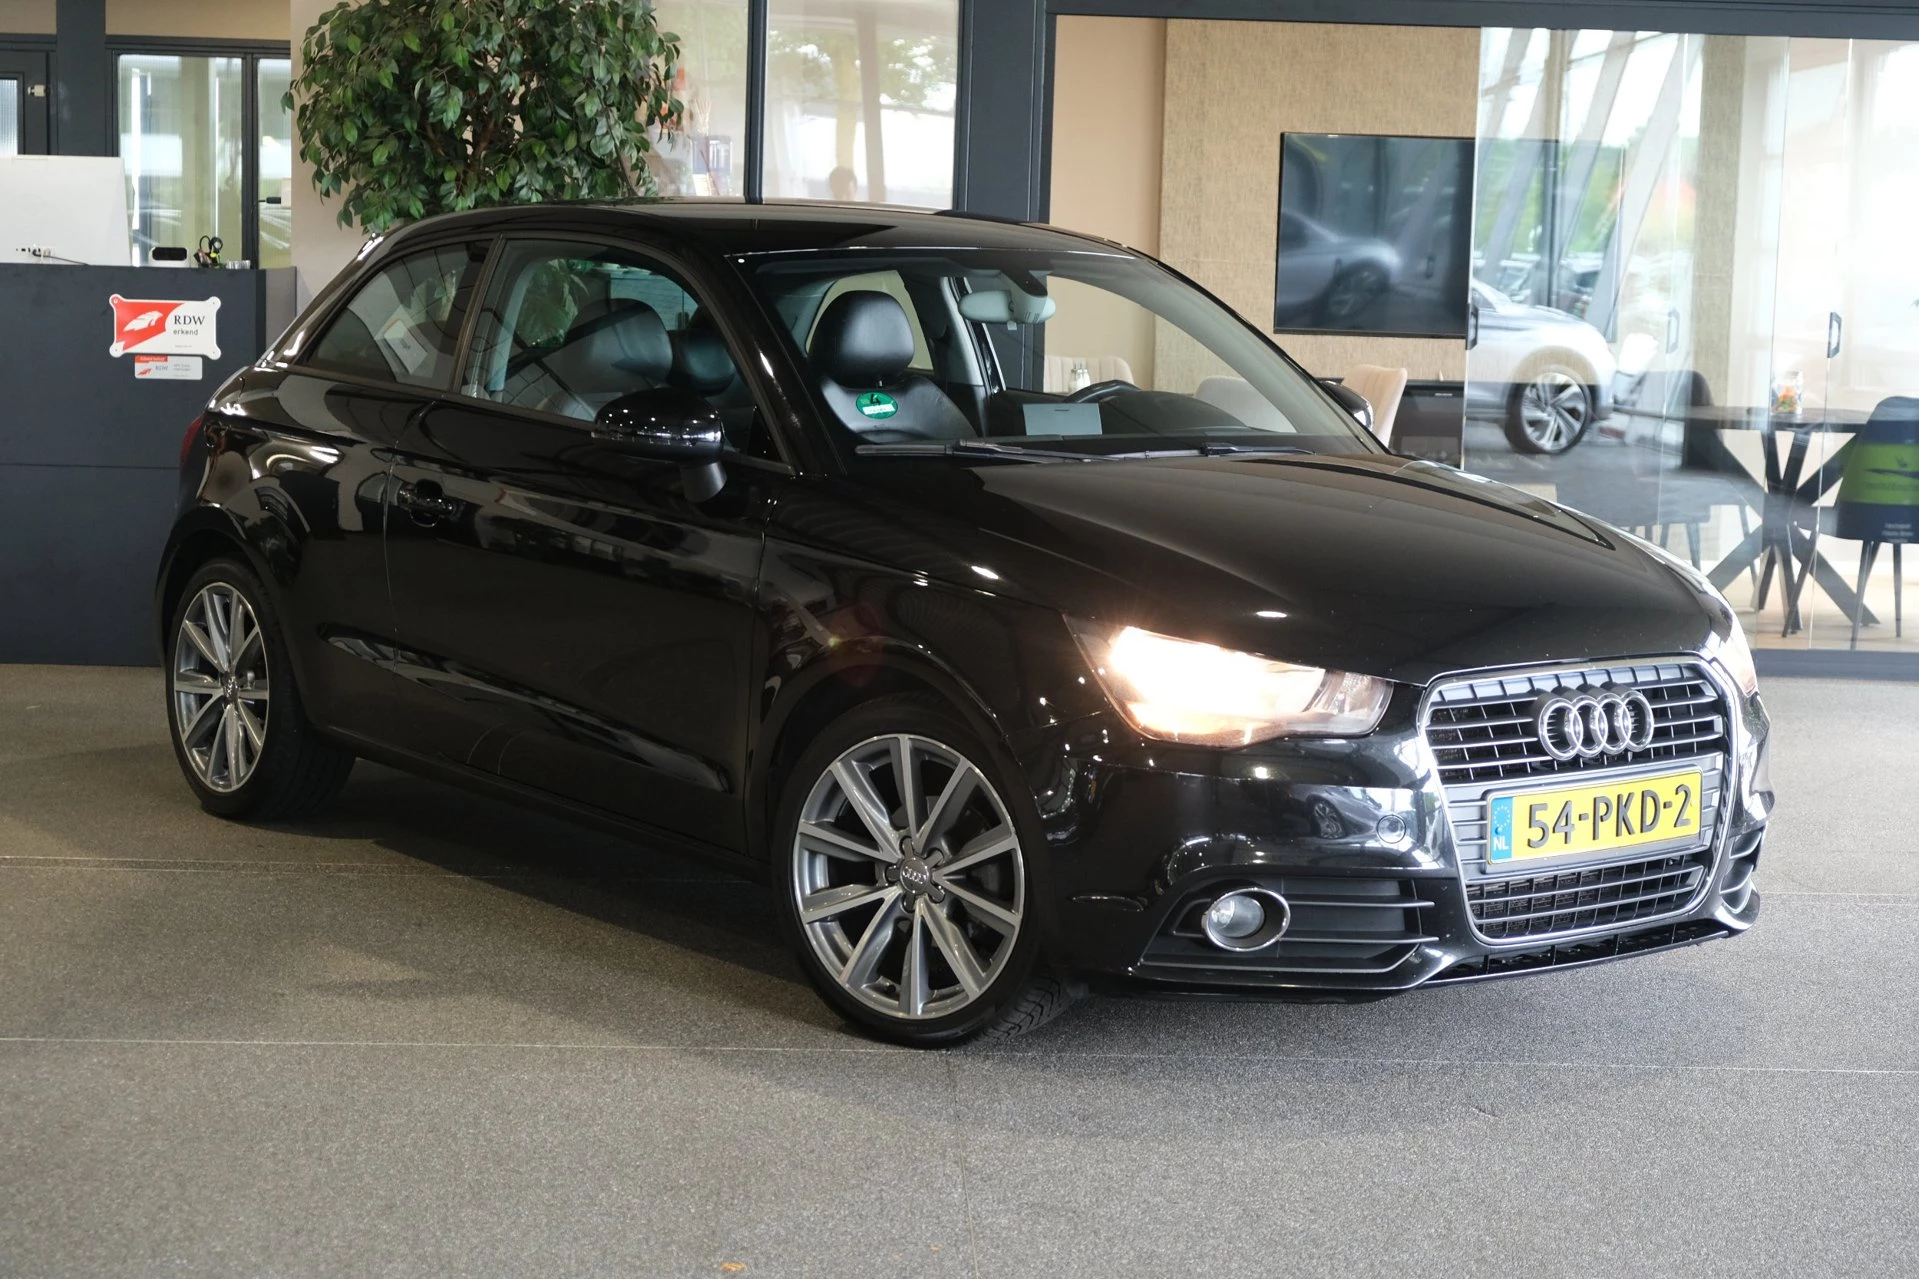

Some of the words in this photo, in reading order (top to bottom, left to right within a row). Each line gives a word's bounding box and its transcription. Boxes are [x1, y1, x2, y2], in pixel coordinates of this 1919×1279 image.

[174, 315, 205, 325] RDW
[173, 328, 198, 336] erkend
[870, 393, 881, 405] 4
[1527, 784, 1692, 848] 54-PKD-2
[1493, 837, 1509, 851] NL
